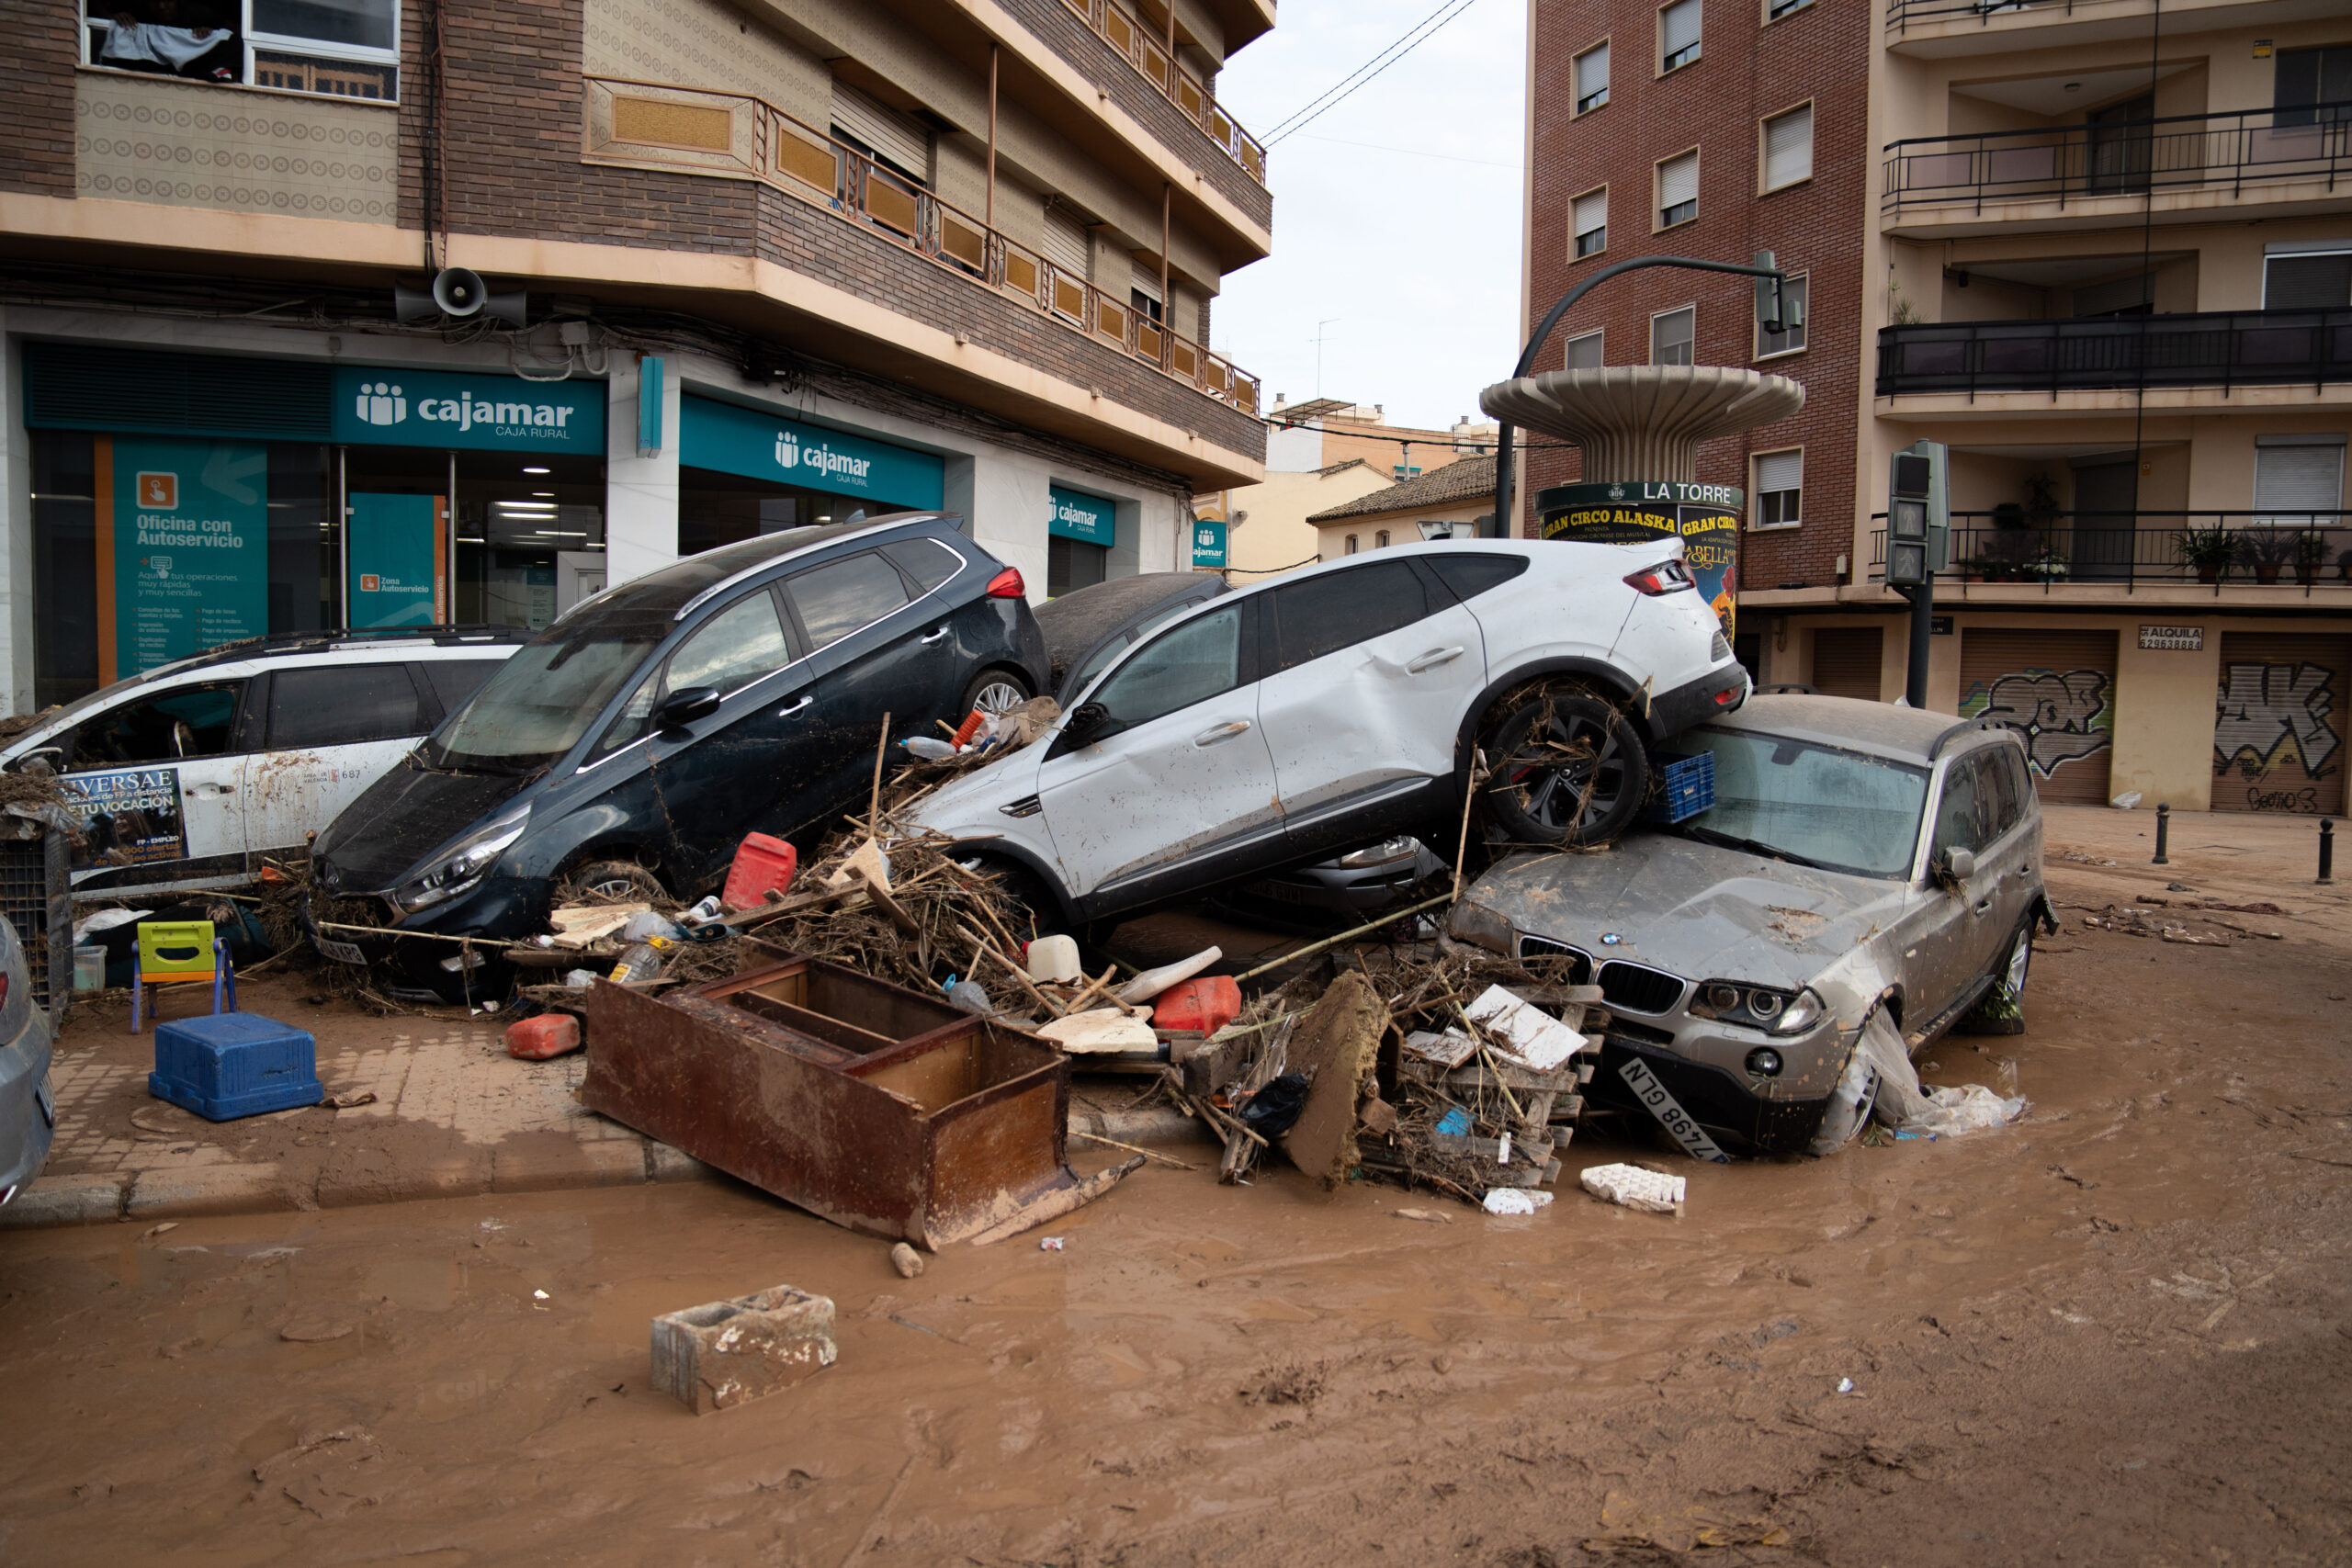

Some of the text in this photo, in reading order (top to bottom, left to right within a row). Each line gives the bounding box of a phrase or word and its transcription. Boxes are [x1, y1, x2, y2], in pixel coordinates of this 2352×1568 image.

[418, 390, 574, 432] cajamar
[495, 426, 571, 440] CAJA RURAL
[803, 443, 870, 477] cajamar
[836, 474, 868, 487] CAJA RURAL
[1645, 482, 1731, 504] LA TORRE
[1058, 502, 1097, 527] cajamar
[137, 514, 232, 532] Oficina con
[1544, 510, 1676, 538] GRAN CIRCO ALASKA
[1682, 517, 1715, 536] GRAN
[137, 530, 243, 548] Autoservicio
[1193, 547, 1223, 558] ajamar
[1687, 546, 1729, 570] BELLA
[186, 574, 238, 582] operaciones
[381, 577, 400, 585] Zona
[160, 581, 191, 590] rápidas
[381, 584, 429, 593] Autoservicio
[166, 589, 202, 597] sencillas
[2141, 627, 2200, 638] SE ALQUILA
[342, 770, 361, 779] 687
[134, 787, 173, 797] distancia
[78, 804, 99, 816] TU
[99, 794, 174, 812] VOCACIÓN
[151, 835, 179, 844] EMPLEO
[147, 851, 182, 860] activas
[1625, 1064, 1715, 1157] 7498 GLN
